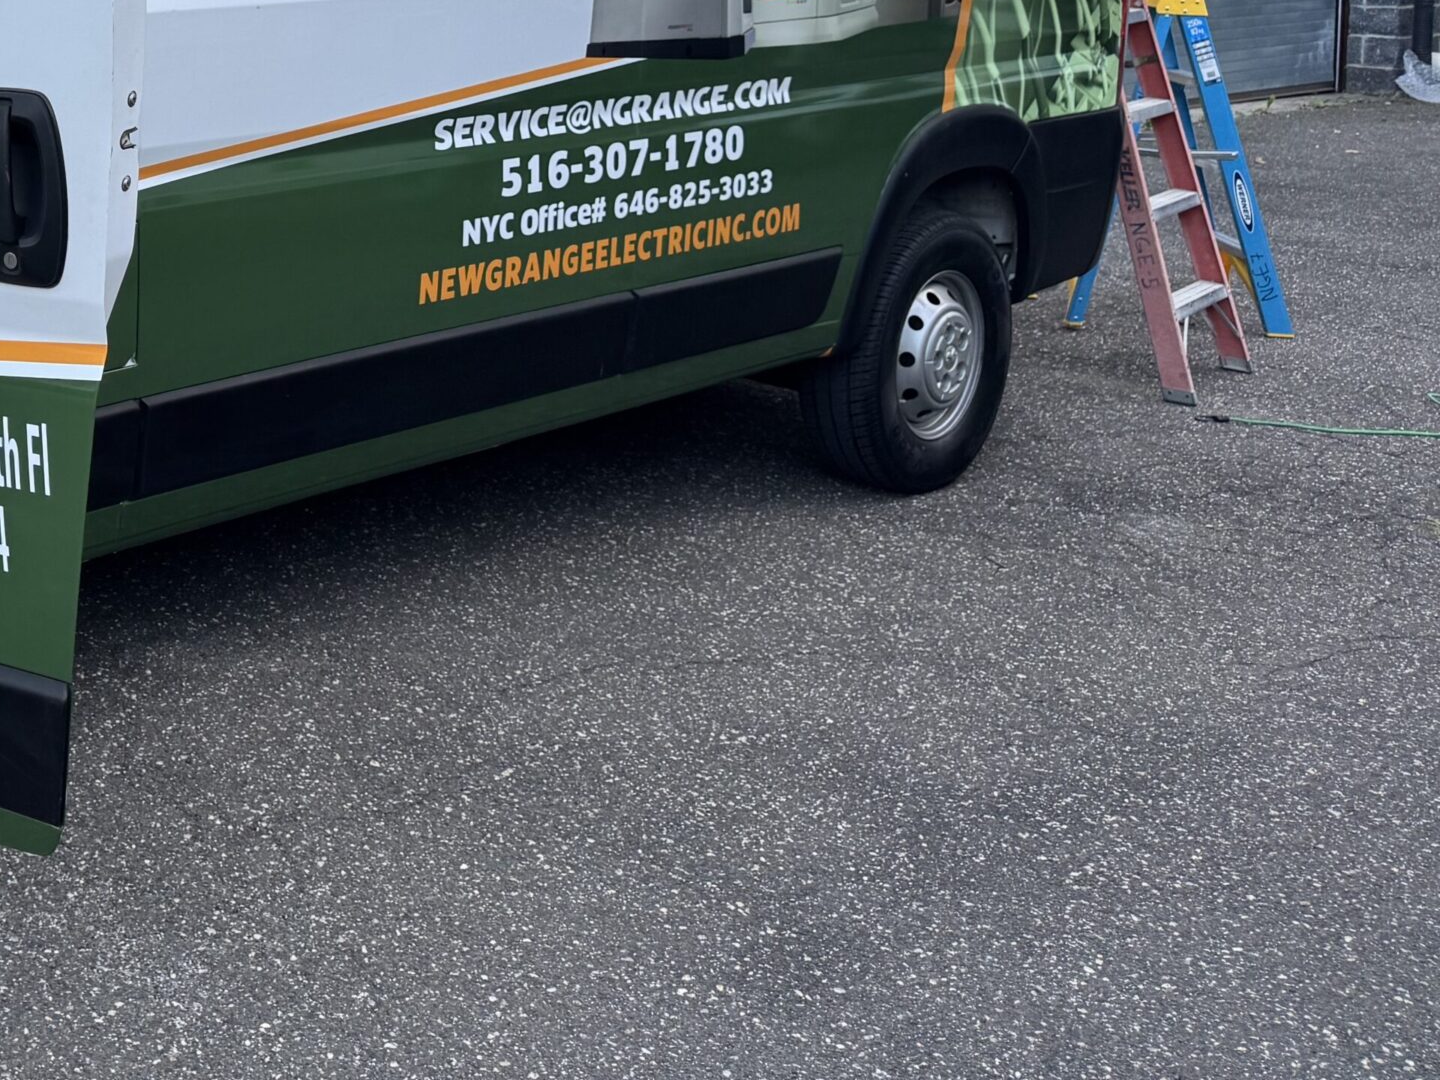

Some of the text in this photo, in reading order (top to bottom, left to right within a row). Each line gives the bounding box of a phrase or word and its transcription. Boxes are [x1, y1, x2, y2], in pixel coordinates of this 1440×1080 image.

[434, 77, 792, 151] SERVICE@NGRANGE.COM
[501, 125, 744, 197] 516-307-1780
[462, 168, 773, 247] NYC Office# 646-825-3033
[1236, 182, 1252, 221] WERNER
[418, 203, 800, 305] NEWGRANGEELECTRICINC.COM
[26, 423, 51, 496] Fl
